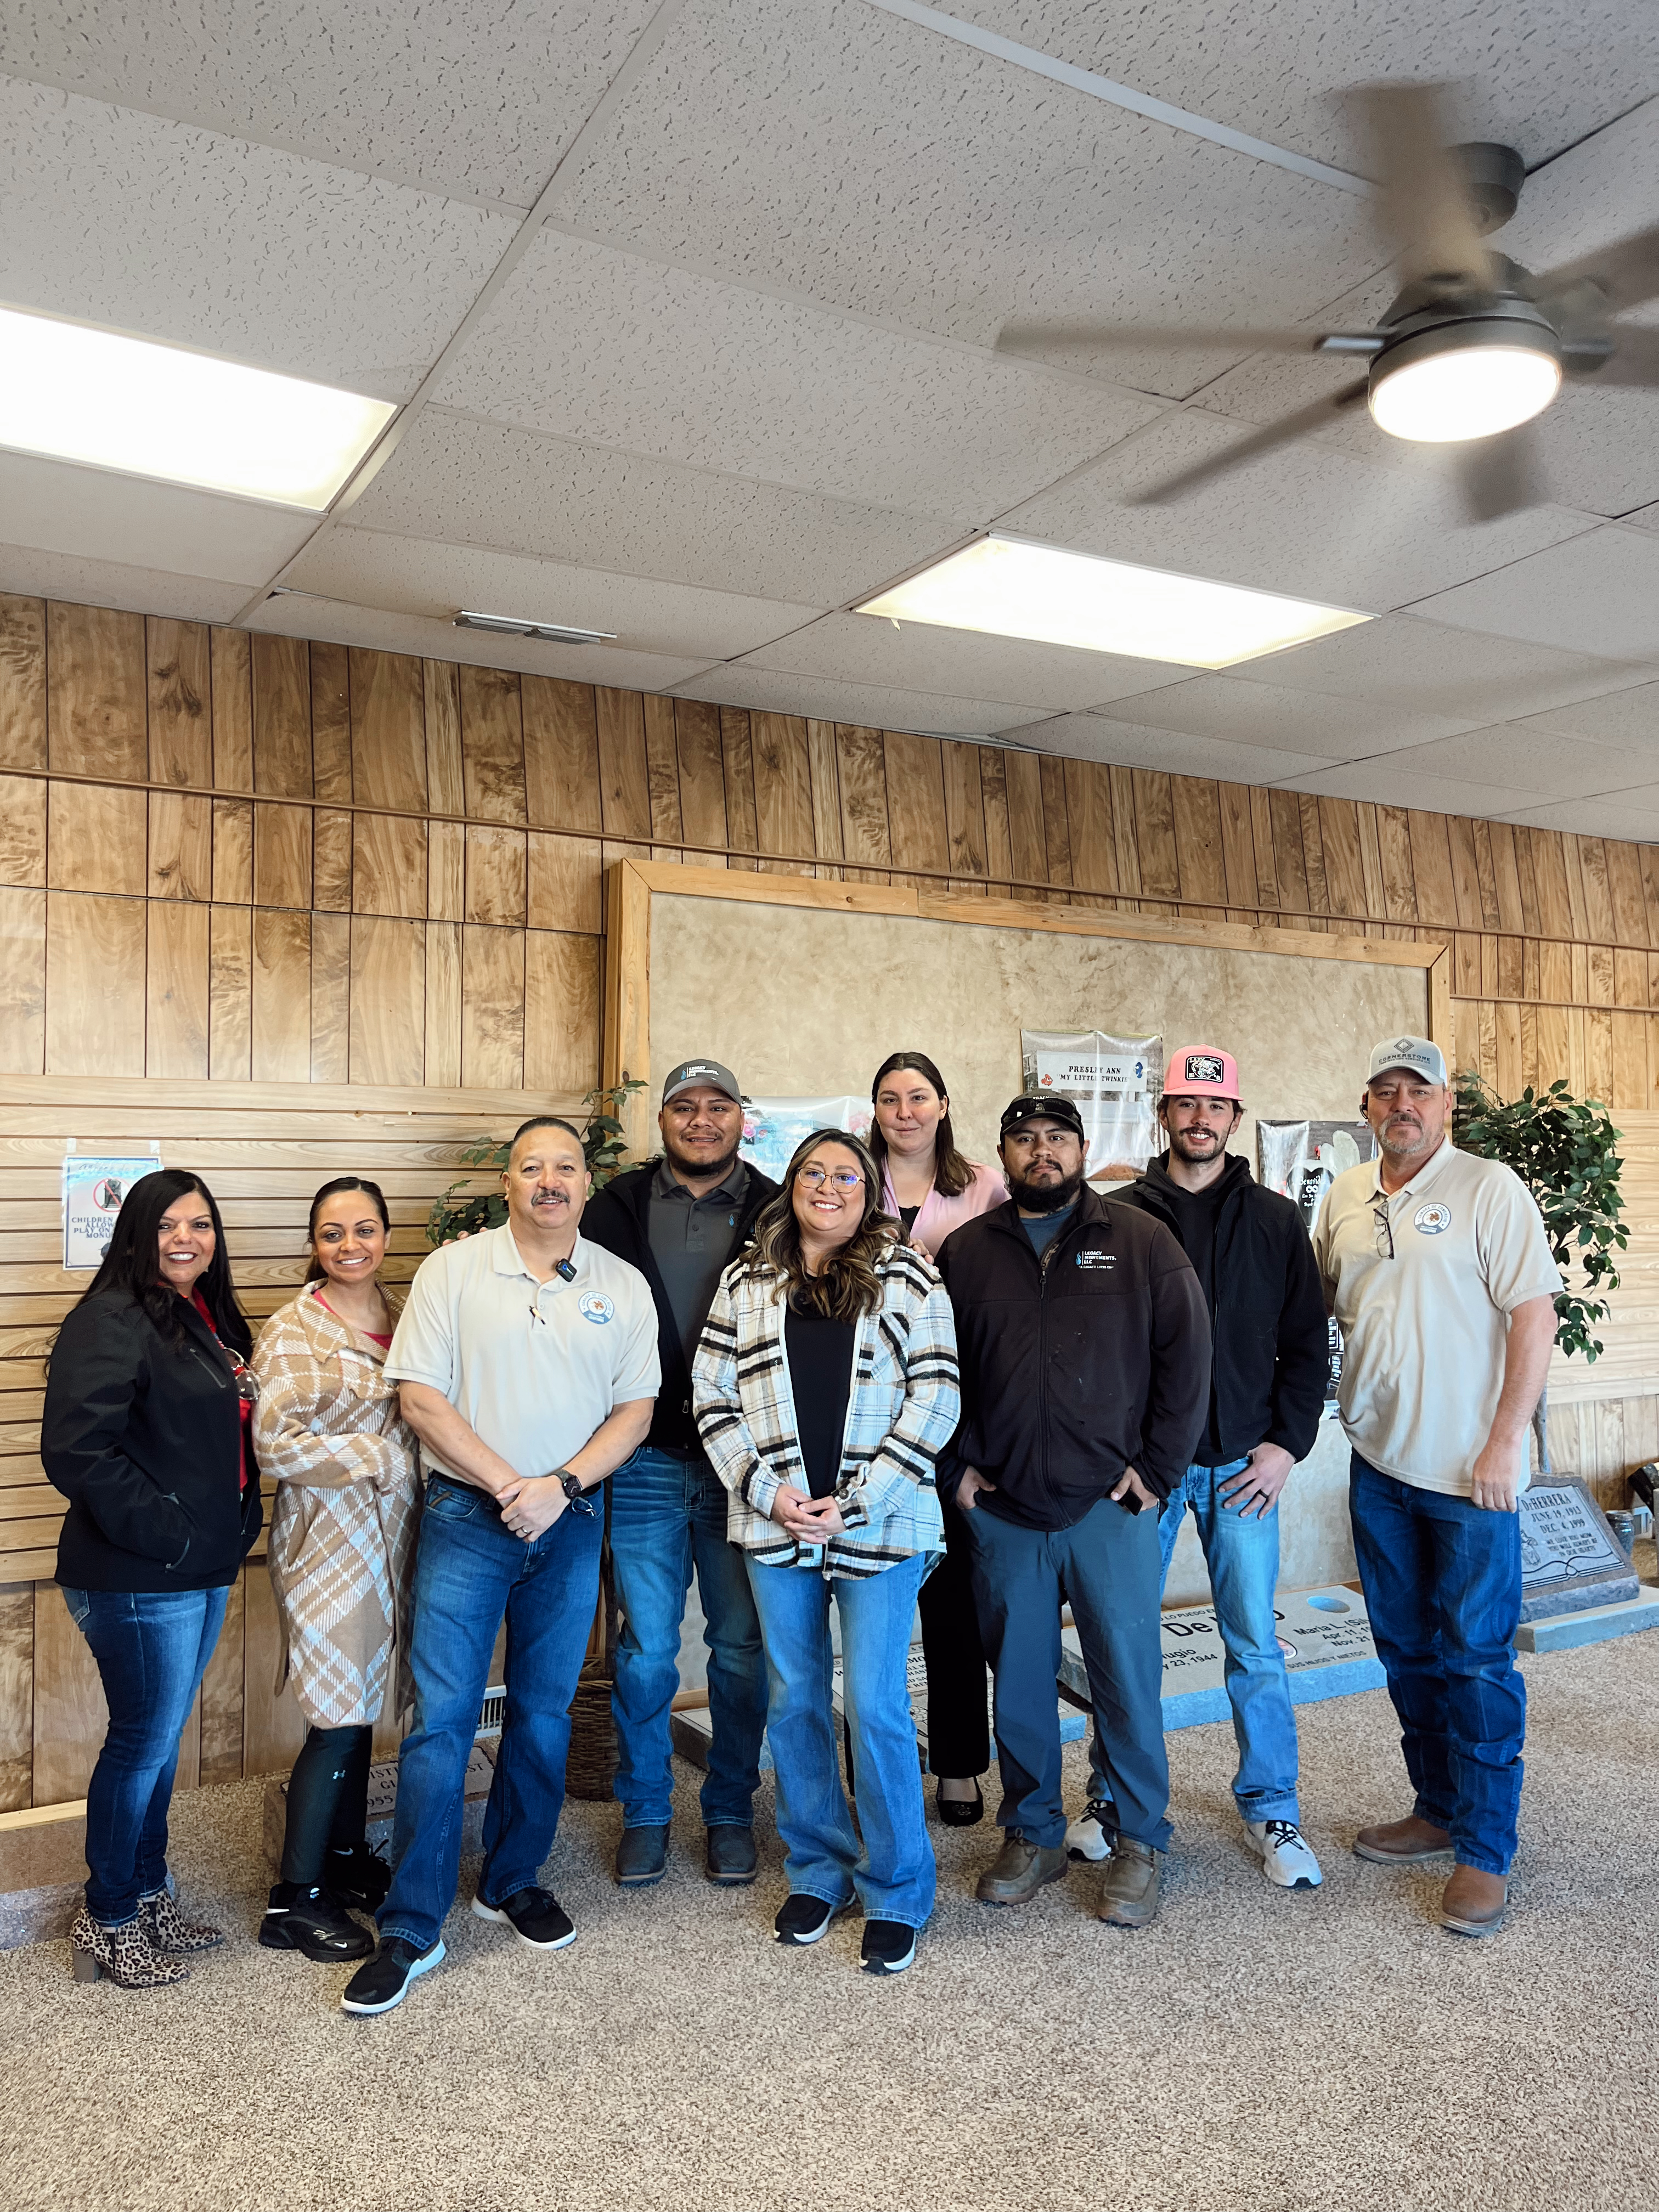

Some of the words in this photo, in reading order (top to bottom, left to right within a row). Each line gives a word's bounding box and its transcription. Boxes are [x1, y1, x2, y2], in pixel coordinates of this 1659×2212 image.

[1379, 1053, 1430, 1063] CORNERSTONE
[1531, 1511, 1552, 1522] JUNE
[1570, 1519, 1585, 1528] 1999
[1161, 1623, 1212, 1637] De
[1293, 1625, 1332, 1635] Maria
[1162, 1649, 1197, 1659] ugio
[1190, 1654, 1218, 1663] 1944
[1305, 1657, 1330, 1665] HIJOS
[1337, 1651, 1367, 1659] NIETOS
[366, 1795, 393, 1808] 955
